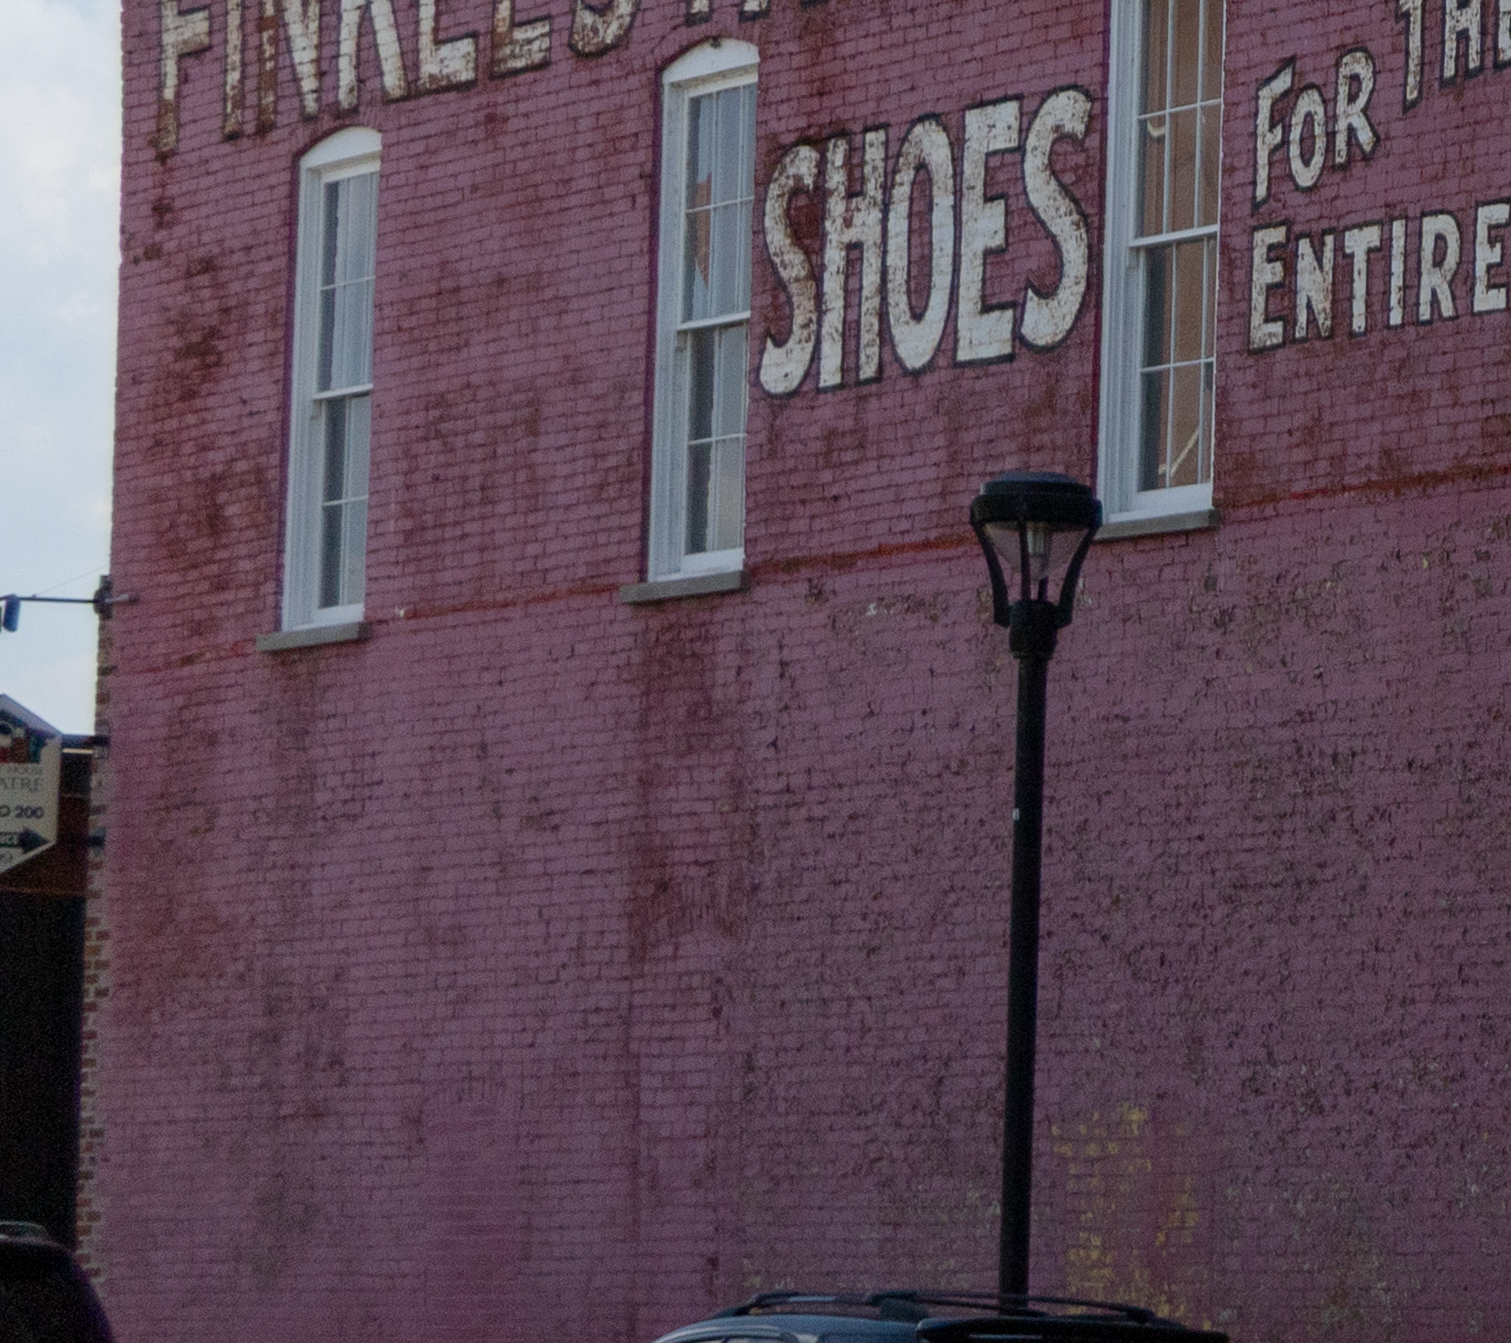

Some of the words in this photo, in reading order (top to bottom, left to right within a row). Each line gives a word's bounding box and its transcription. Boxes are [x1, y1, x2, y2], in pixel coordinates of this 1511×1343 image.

[1252, 45, 1380, 212] FOR
[758, 85, 1092, 398] SHOES
[15, 806, 44, 818] 200
